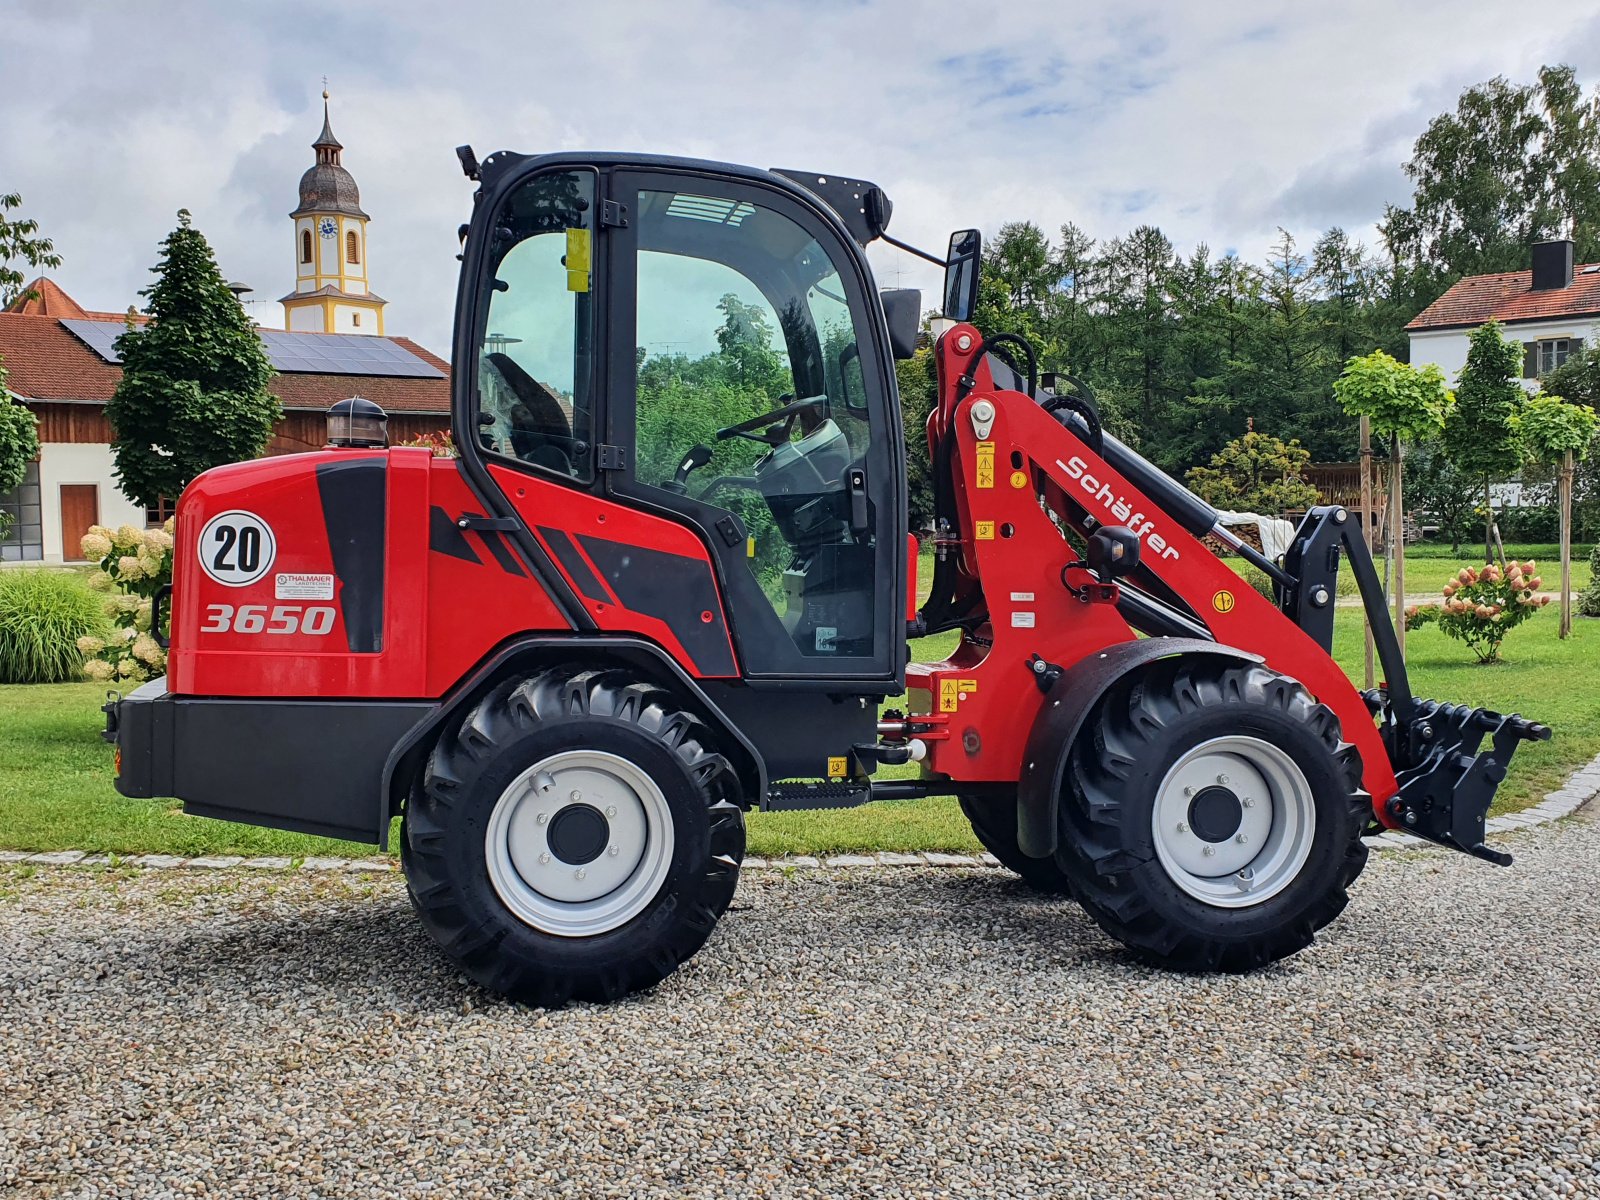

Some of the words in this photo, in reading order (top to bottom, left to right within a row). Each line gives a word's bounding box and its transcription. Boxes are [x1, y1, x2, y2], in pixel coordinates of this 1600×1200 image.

[1055, 456, 1180, 560] Schäffer
[213, 525, 261, 573] 20
[200, 604, 336, 635] 3650
